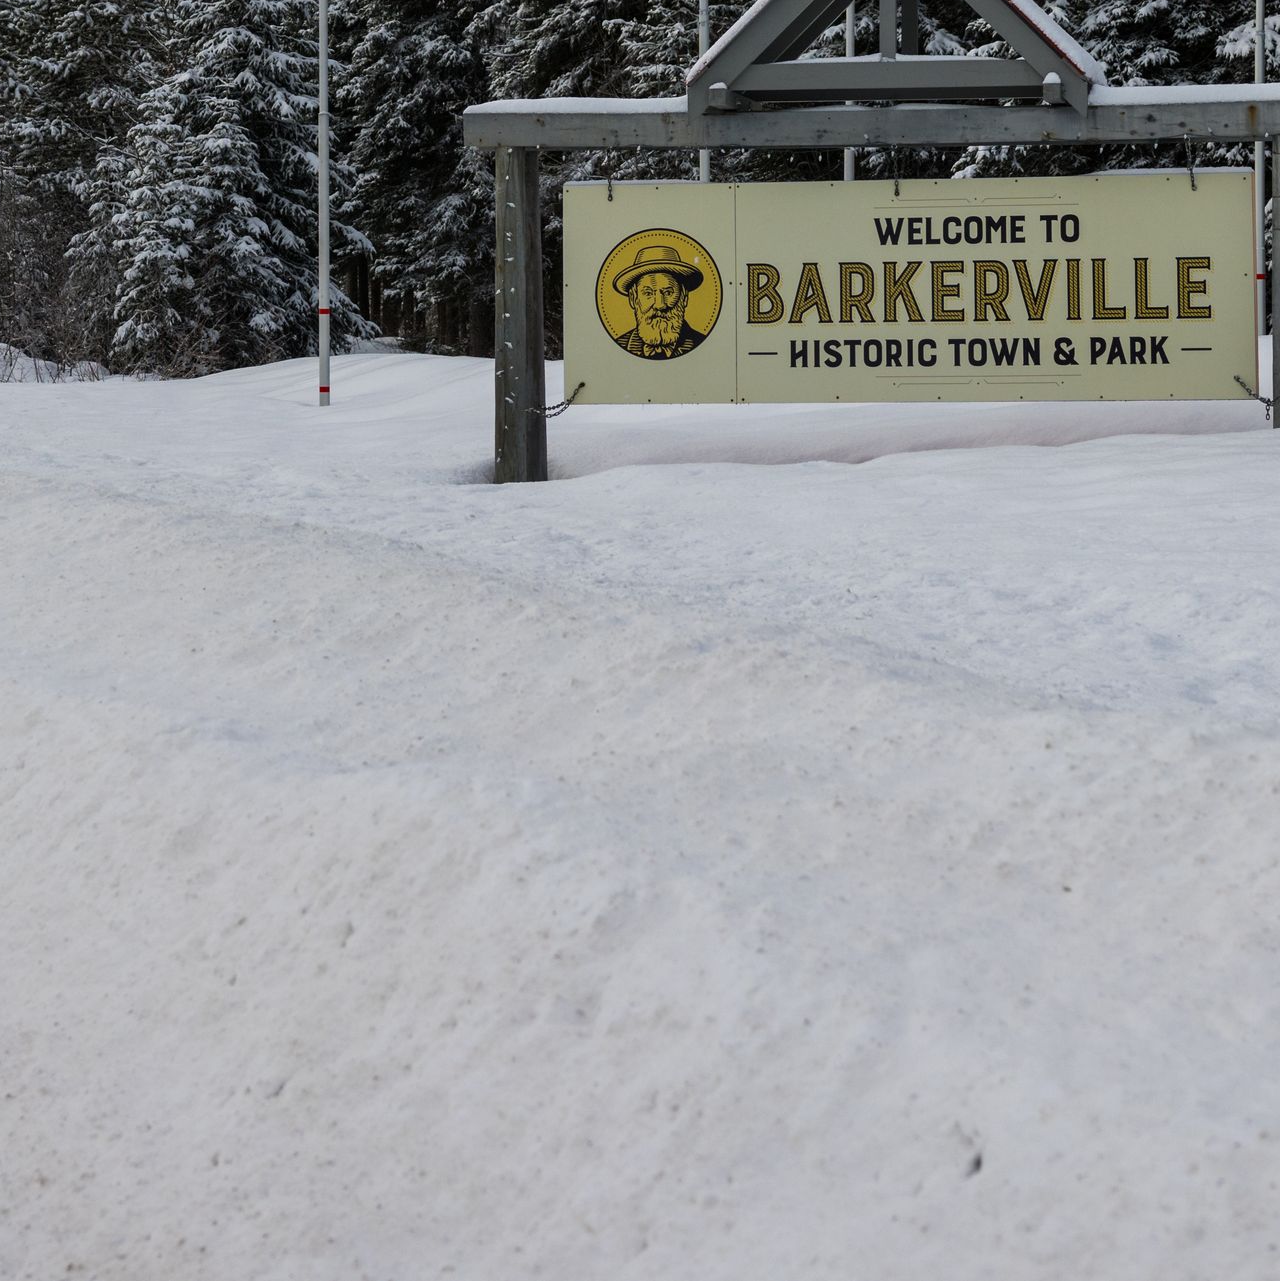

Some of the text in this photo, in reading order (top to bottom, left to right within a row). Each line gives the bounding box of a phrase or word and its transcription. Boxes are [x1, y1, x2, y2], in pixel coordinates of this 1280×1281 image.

[873, 213, 1080, 246] WELCOME TO
[746, 255, 1213, 324] BARKERVILLE
[789, 335, 1170, 368] HISTORIC TOWN & PARK
